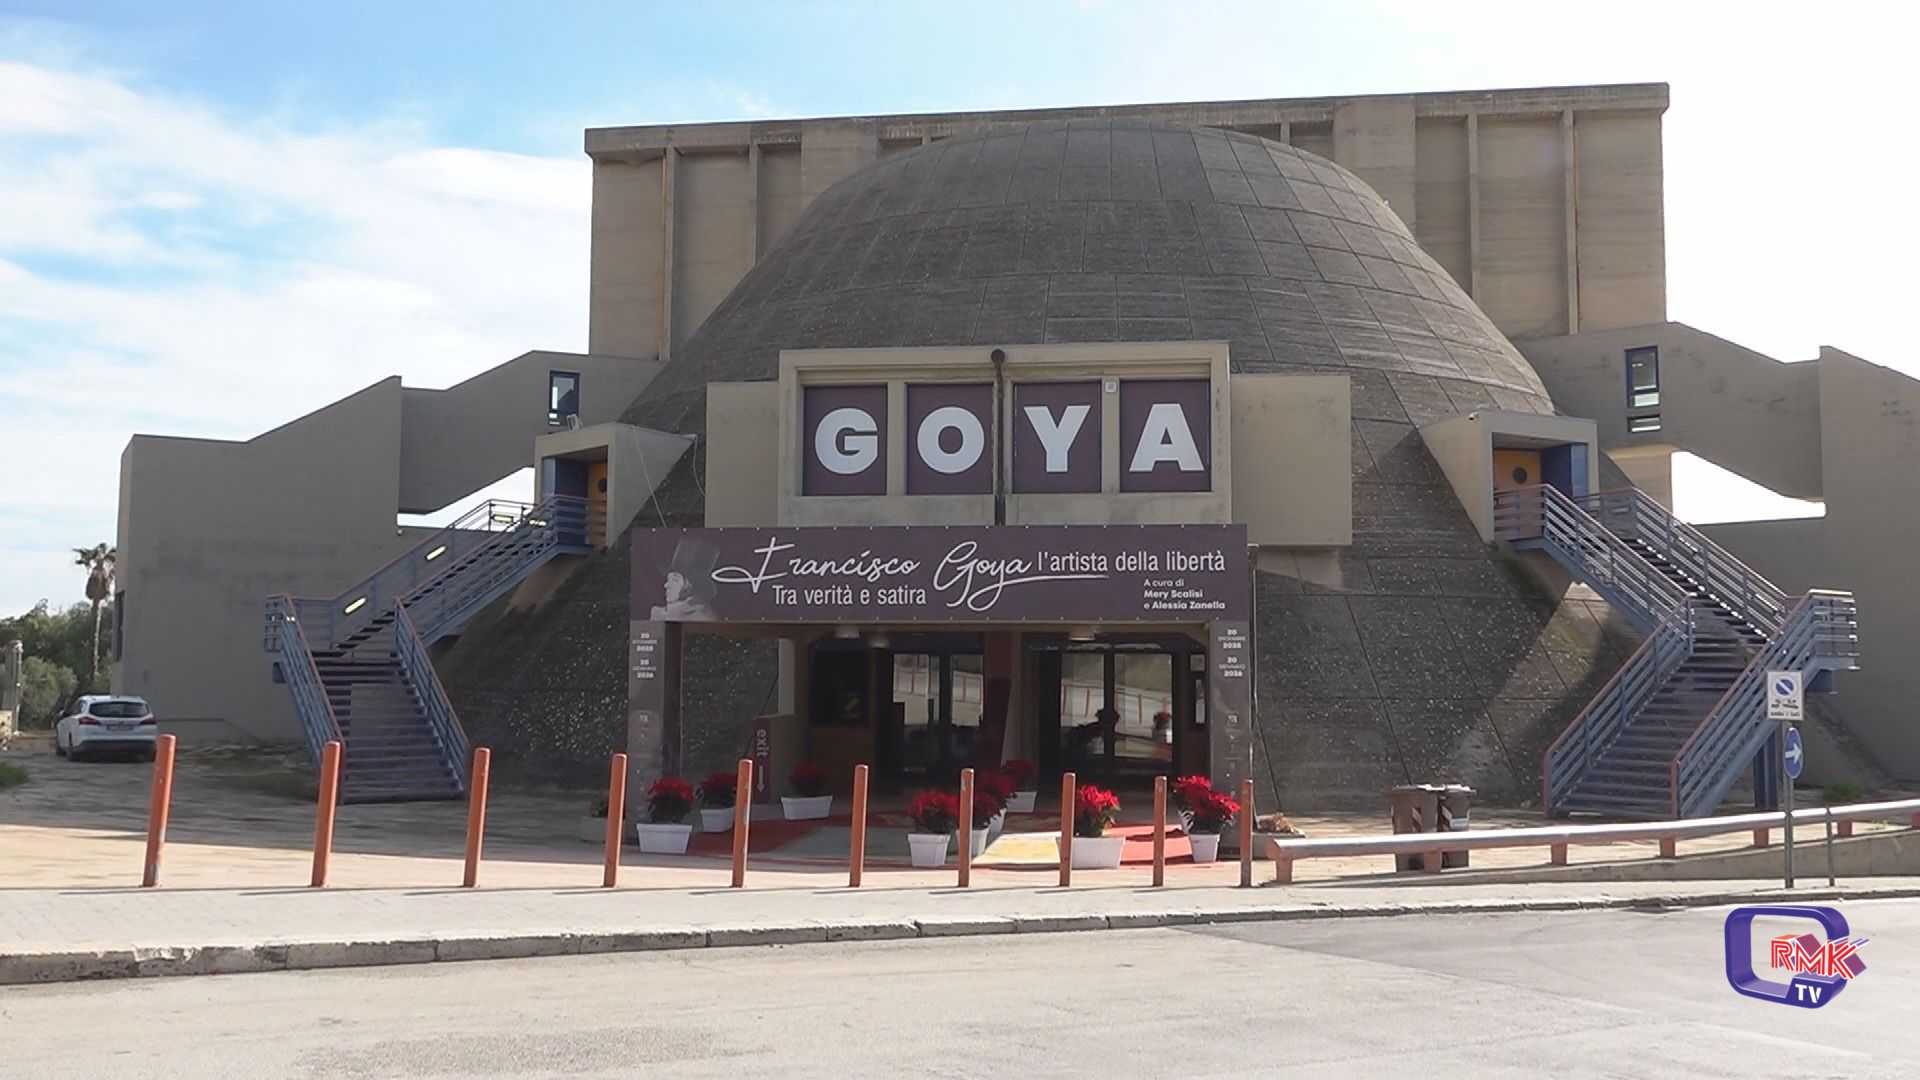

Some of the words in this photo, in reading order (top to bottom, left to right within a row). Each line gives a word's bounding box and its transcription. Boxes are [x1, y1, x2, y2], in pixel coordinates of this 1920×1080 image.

[815, 403, 1205, 475] GOYA
[711, 536, 921, 593] Francisco
[932, 541, 1110, 612] Goya
[1038, 551, 1108, 572] l'artista
[1115, 551, 1159, 572] della
[1166, 550, 1225, 572] libertà
[1143, 578, 1151, 587] A
[1152, 579, 1173, 587] cura
[1175, 578, 1185, 587] di
[772, 584, 797, 605] Tra
[804, 584, 853, 605] verità
[860, 589, 871, 605] e
[877, 586, 927, 605] satira
[1143, 589, 1169, 599] Mery
[1171, 589, 1204, 598] Scalisi
[1152, 601, 1188, 609] Alessia
[1189, 601, 1226, 609] Zanella
[756, 728, 769, 757] exit
